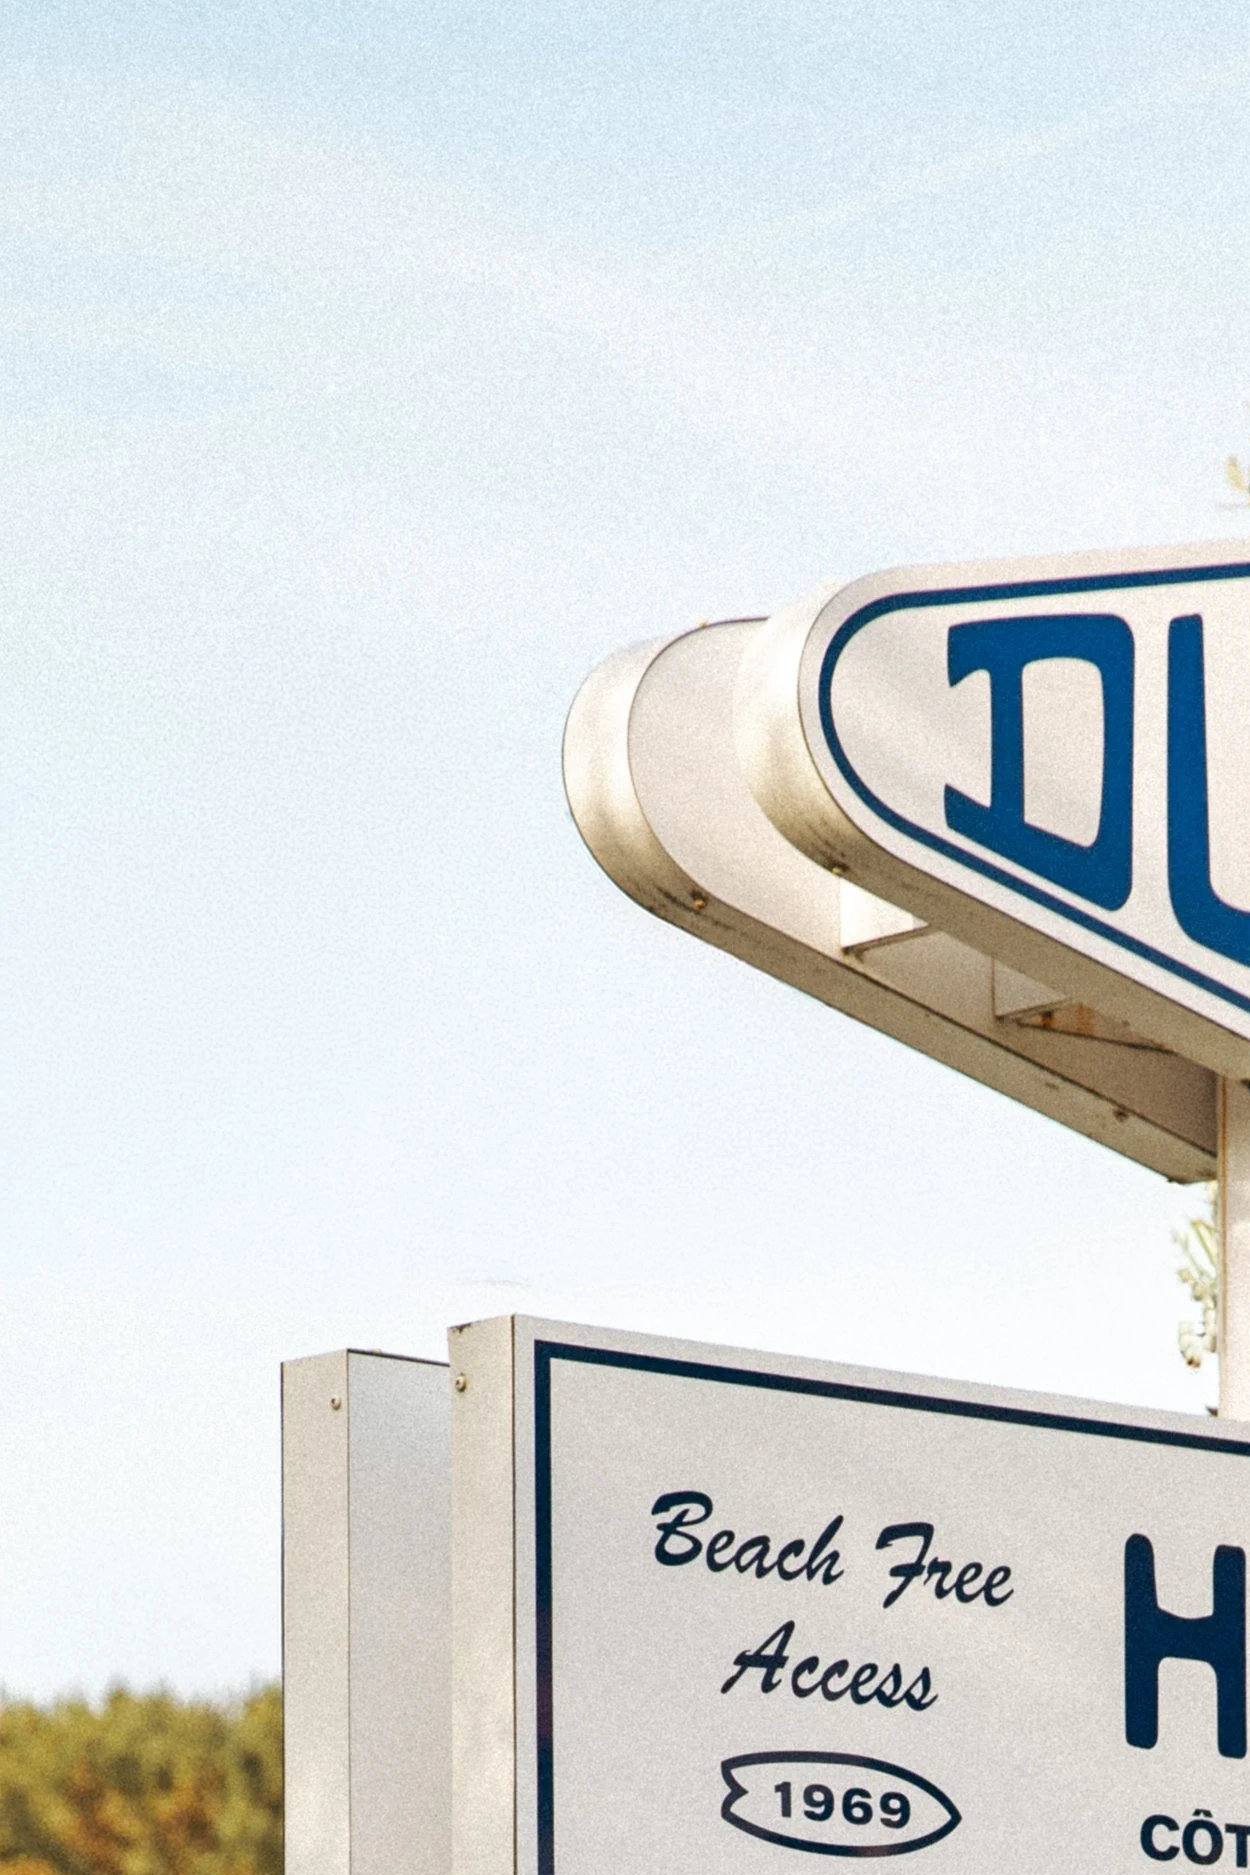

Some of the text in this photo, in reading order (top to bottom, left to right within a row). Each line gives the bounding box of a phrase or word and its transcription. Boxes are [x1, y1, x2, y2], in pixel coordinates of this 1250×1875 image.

[650, 1491, 1014, 1609] Beach Free
[720, 1620, 938, 1711] Access
[773, 1781, 911, 1829] 1969
